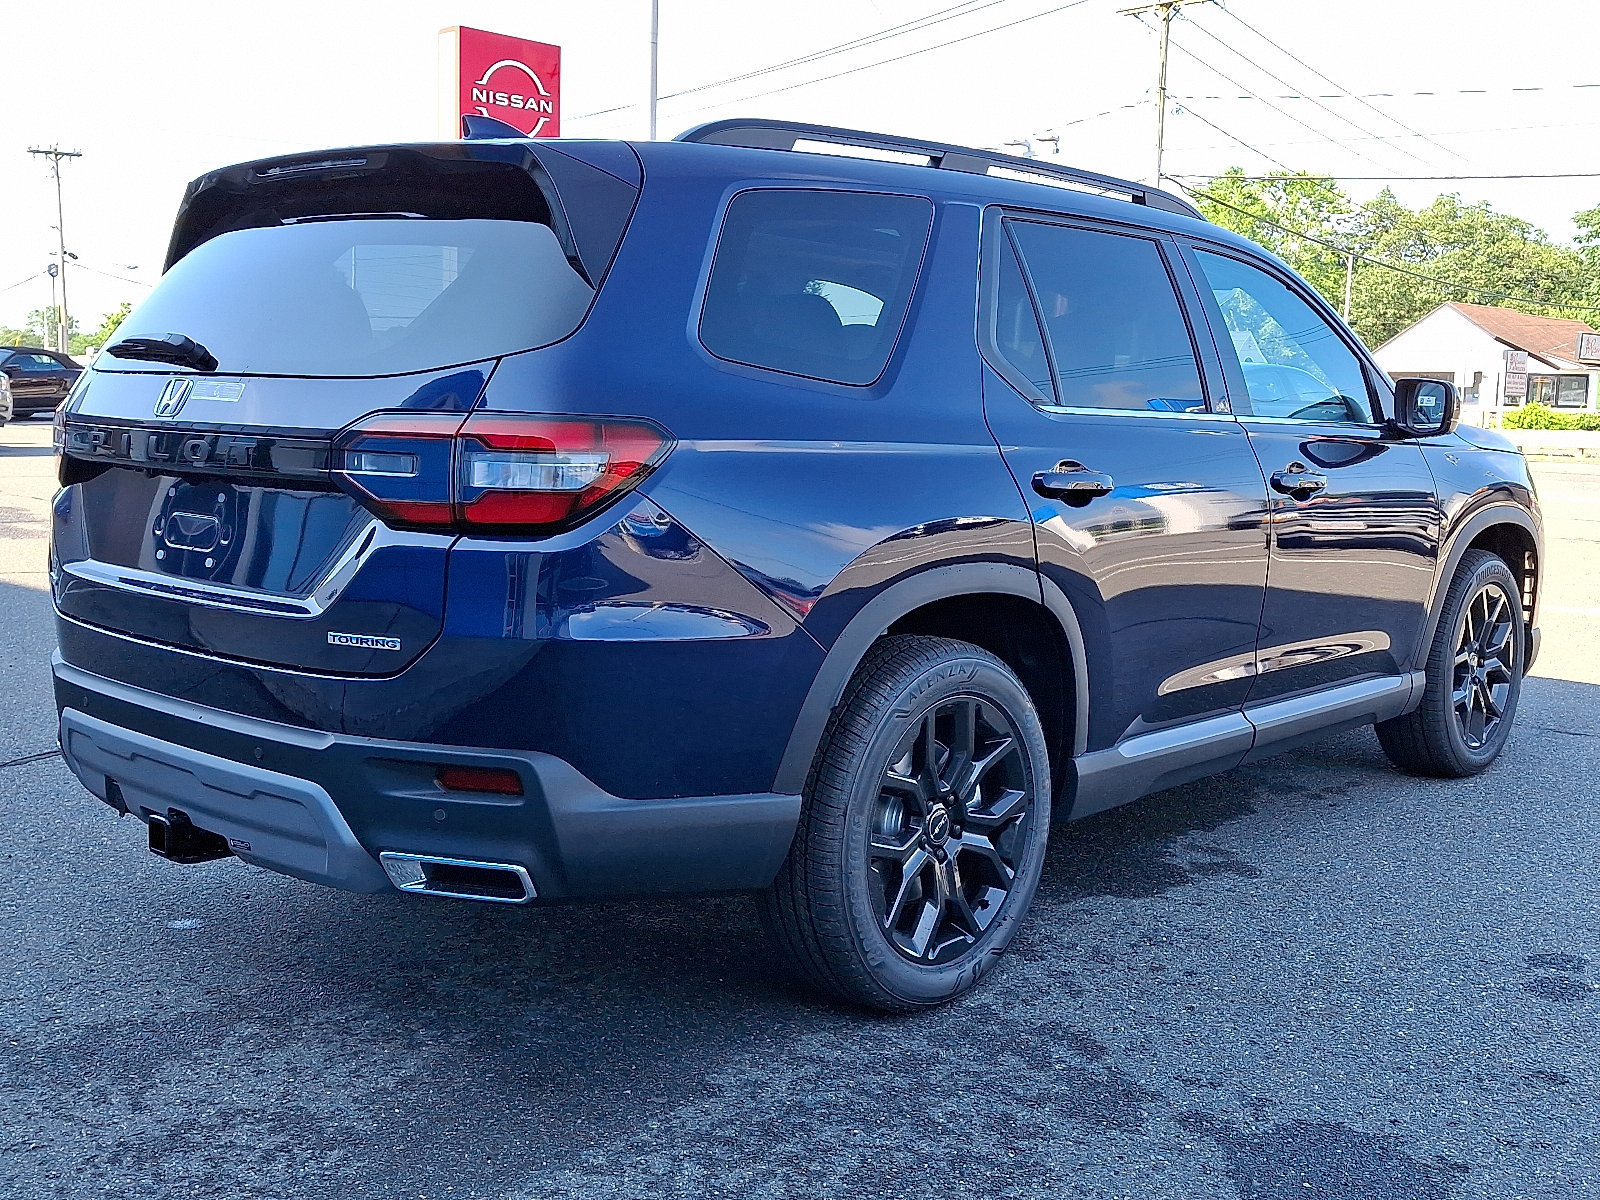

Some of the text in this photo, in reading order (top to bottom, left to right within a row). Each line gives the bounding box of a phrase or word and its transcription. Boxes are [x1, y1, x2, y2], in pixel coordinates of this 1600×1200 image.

[472, 87, 553, 114] NISSAN
[88, 430, 258, 466] PILOT
[329, 633, 398, 649] TOURING
[909, 663, 967, 705] ALENZA
